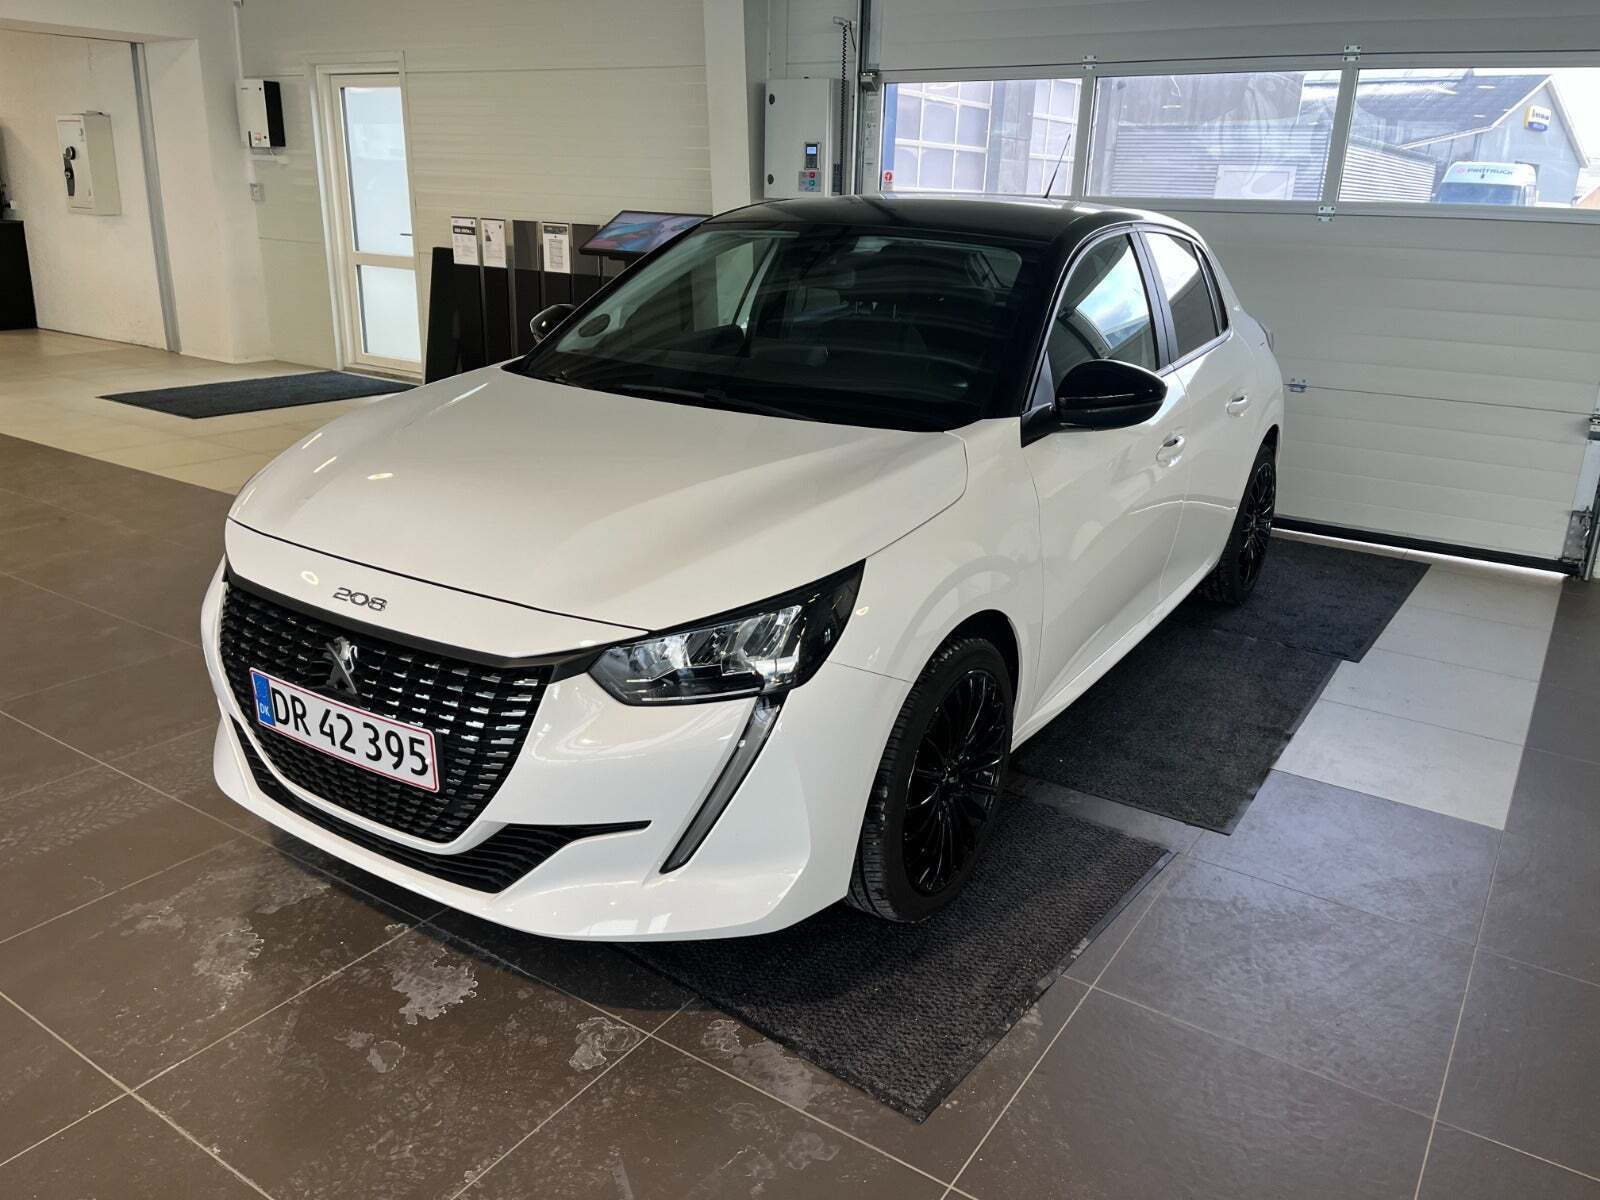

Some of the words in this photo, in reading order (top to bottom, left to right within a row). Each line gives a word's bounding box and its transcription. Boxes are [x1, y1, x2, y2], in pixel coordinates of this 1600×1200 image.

[333, 587, 388, 611] 208
[259, 702, 271, 717] DK
[271, 687, 312, 737] DR
[319, 708, 356, 755] 42
[362, 721, 429, 777] 395
